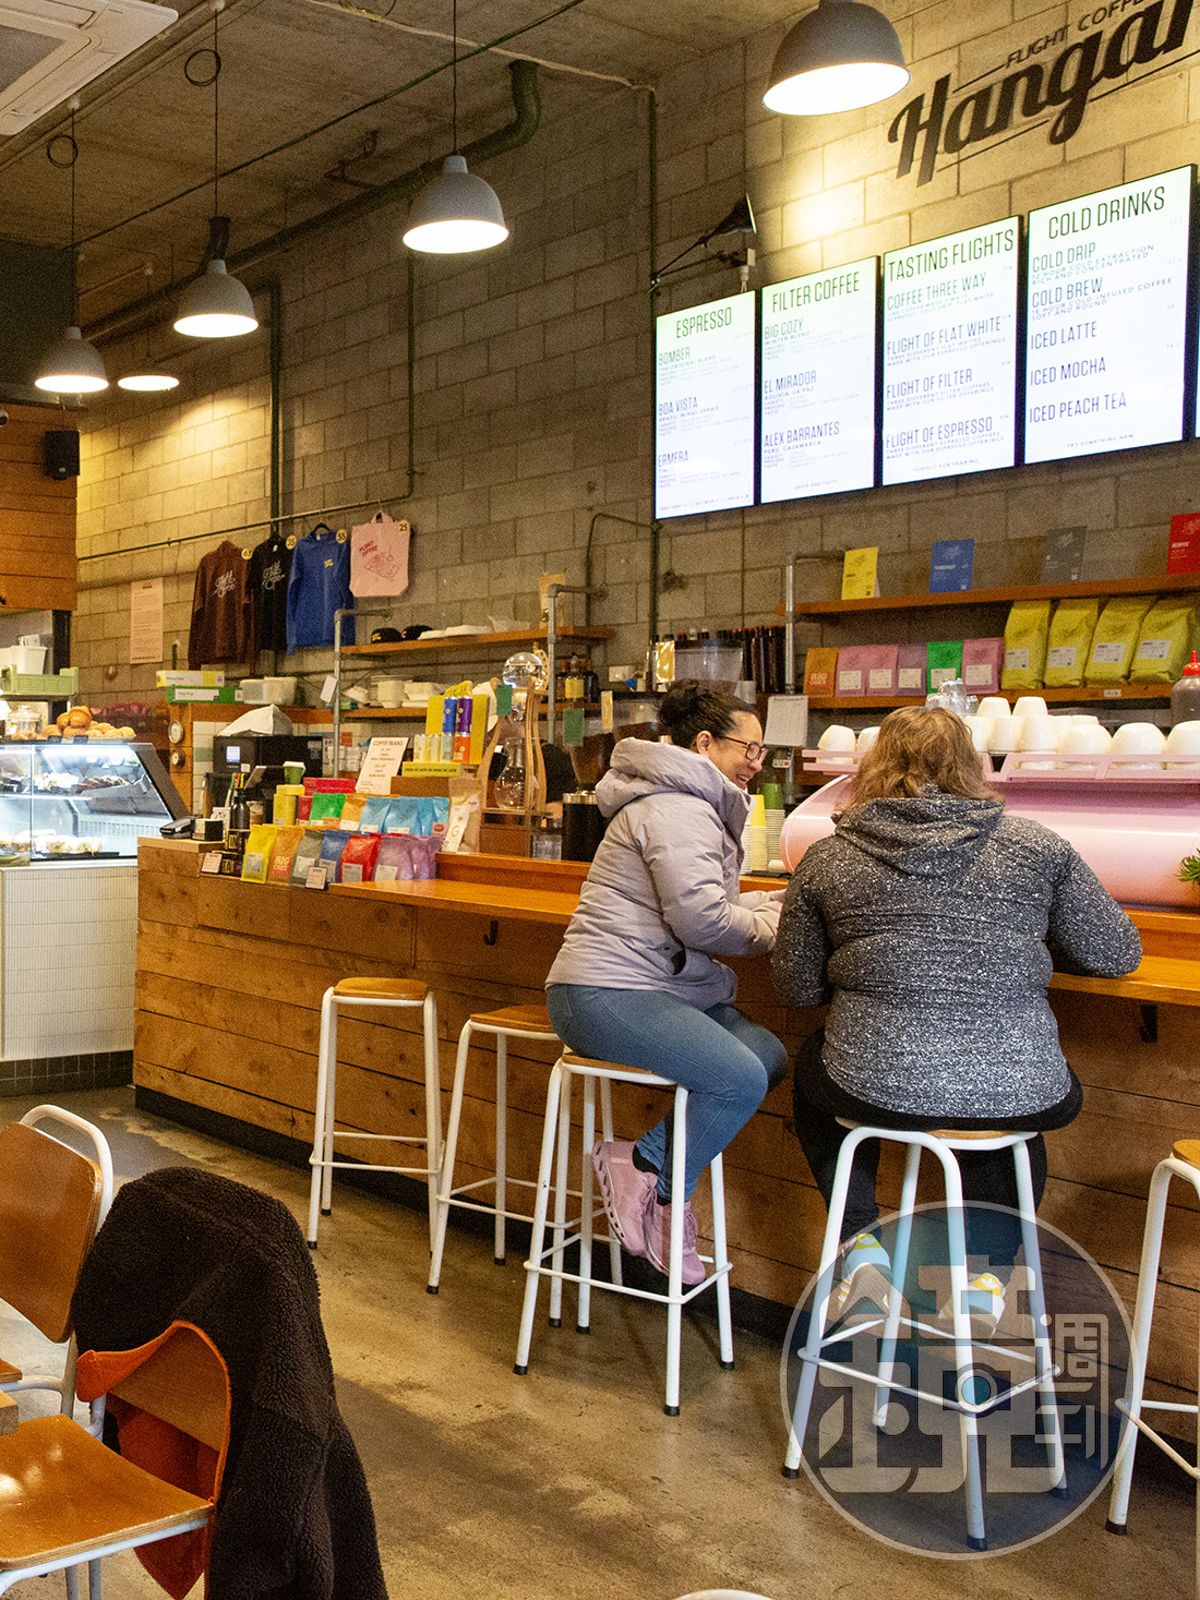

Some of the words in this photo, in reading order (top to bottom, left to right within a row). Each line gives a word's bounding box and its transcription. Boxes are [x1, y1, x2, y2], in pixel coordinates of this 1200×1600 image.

[1004, 24, 1069, 68] FLIGHT
[1049, 207, 1091, 240] COLD
[1097, 186, 1165, 227] DRINKS
[888, 247, 948, 282] TASTING
[952, 229, 1014, 266] FLIGHTS
[1032, 250, 1063, 274] COLD
[1067, 241, 1096, 264] DRIP
[1055, 270, 1072, 280] AND
[1075, 251, 1148, 275] CONCENTRATED
[1096, 244, 1154, 264] EXTRACTION
[772, 284, 811, 314] FILTER
[814, 271, 860, 303] COFFEE
[887, 288, 923, 311] COFFEE
[926, 279, 957, 301] THREE
[962, 272, 986, 292] WAY
[1032, 286, 1063, 309] COLD
[1067, 276, 1103, 301] BREW
[1137, 276, 1171, 292] COFFEE
[676, 306, 732, 340] ESPRESSO
[1055, 306, 1072, 316] AND
[765, 323, 778, 340] BIG
[780, 318, 804, 337] COZY
[887, 334, 921, 356] FLIGHT
[924, 331, 935, 348] OF
[939, 324, 963, 344] FLAT
[967, 316, 1001, 338] WHITE
[1030, 329, 1057, 350] ICED
[1061, 320, 1097, 344] LATTE
[659, 346, 691, 366] BOMBER
[1030, 366, 1057, 387] ICED
[1060, 356, 1106, 381] MOCHA
[764, 379, 771, 394] EL
[776, 369, 816, 391] MIRADOR
[887, 379, 920, 399] FLIGHT
[923, 375, 935, 392] OF
[938, 368, 972, 389] FILTER
[659, 401, 673, 417] BOA
[676, 395, 698, 413] VISTA
[1029, 403, 1056, 424] ICED
[1059, 396, 1099, 419] PEACH
[1104, 391, 1127, 411] TEA
[764, 432, 784, 448] ALEX
[787, 420, 840, 444] BARRANTES
[886, 429, 919, 449] FLIGHT
[922, 426, 934, 443] OF
[938, 416, 992, 440] ESPRESSO
[275, 855, 290, 865] BIG
